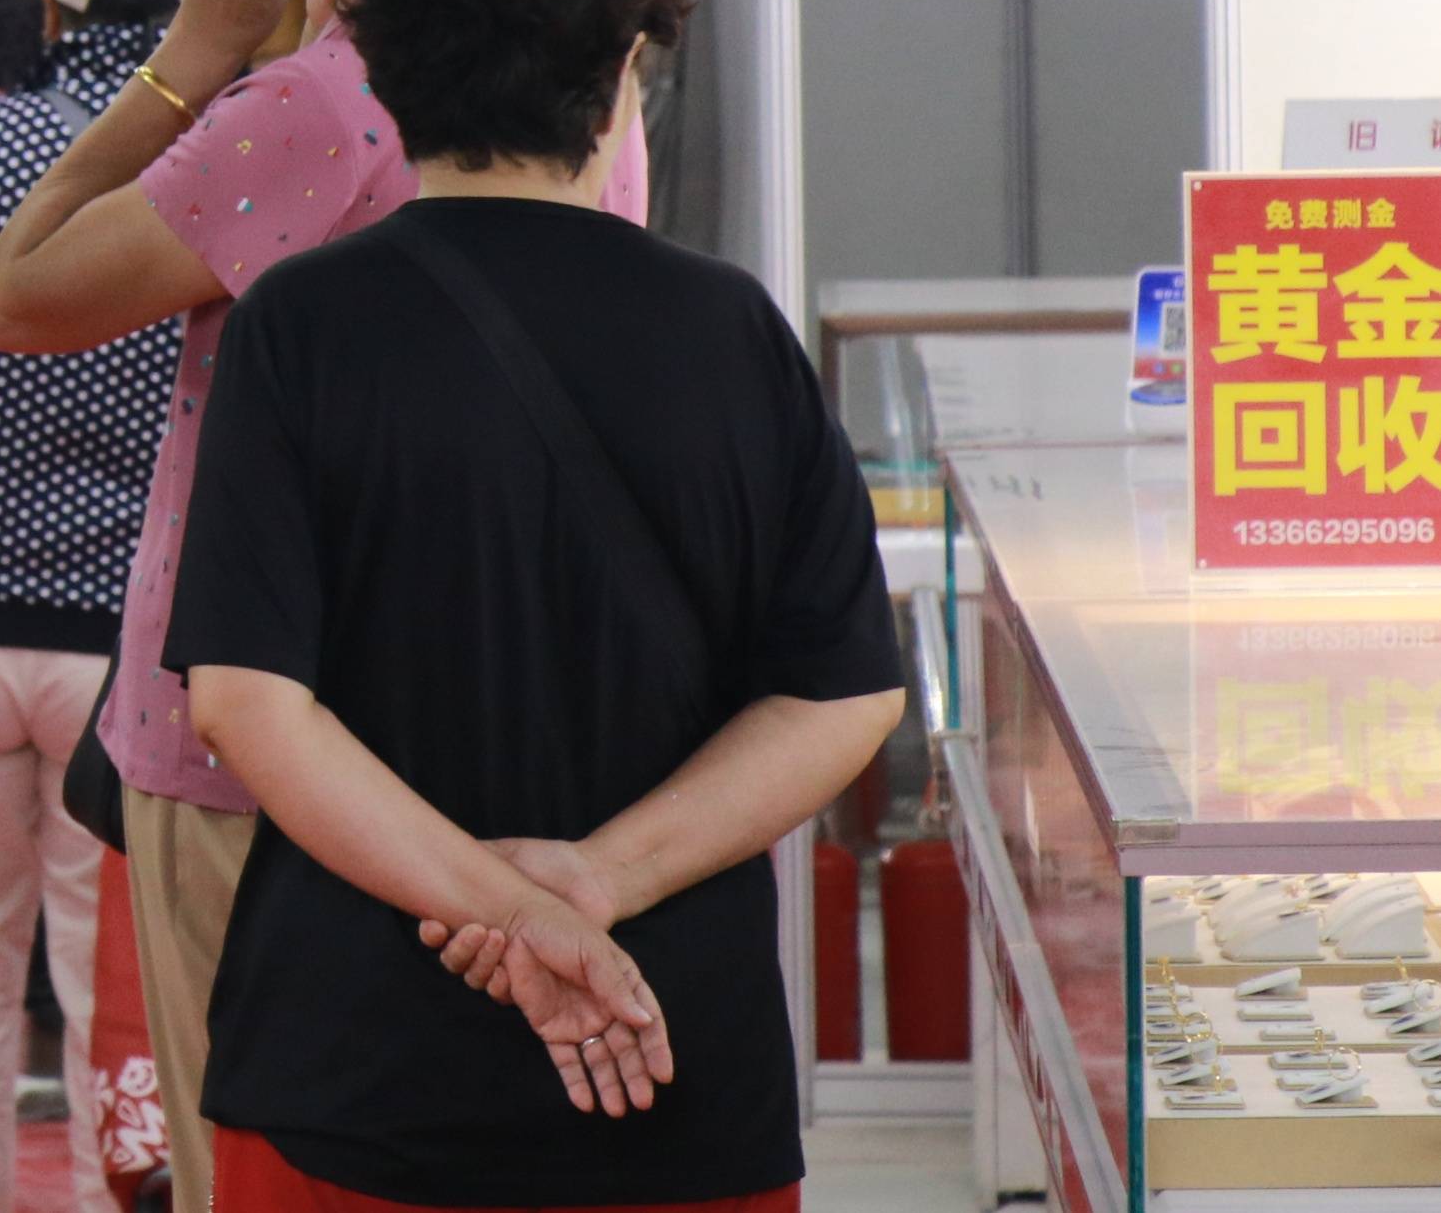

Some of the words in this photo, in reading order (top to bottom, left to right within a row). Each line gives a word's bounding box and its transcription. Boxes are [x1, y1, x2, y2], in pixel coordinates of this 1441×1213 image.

[1348, 119, 1378, 153] 旧
[1264, 198, 1396, 230] 免费测金
[1208, 242, 1441, 365] 黄金
[1213, 374, 1441, 497] 回收
[1232, 517, 1435, 547] 13366295096
